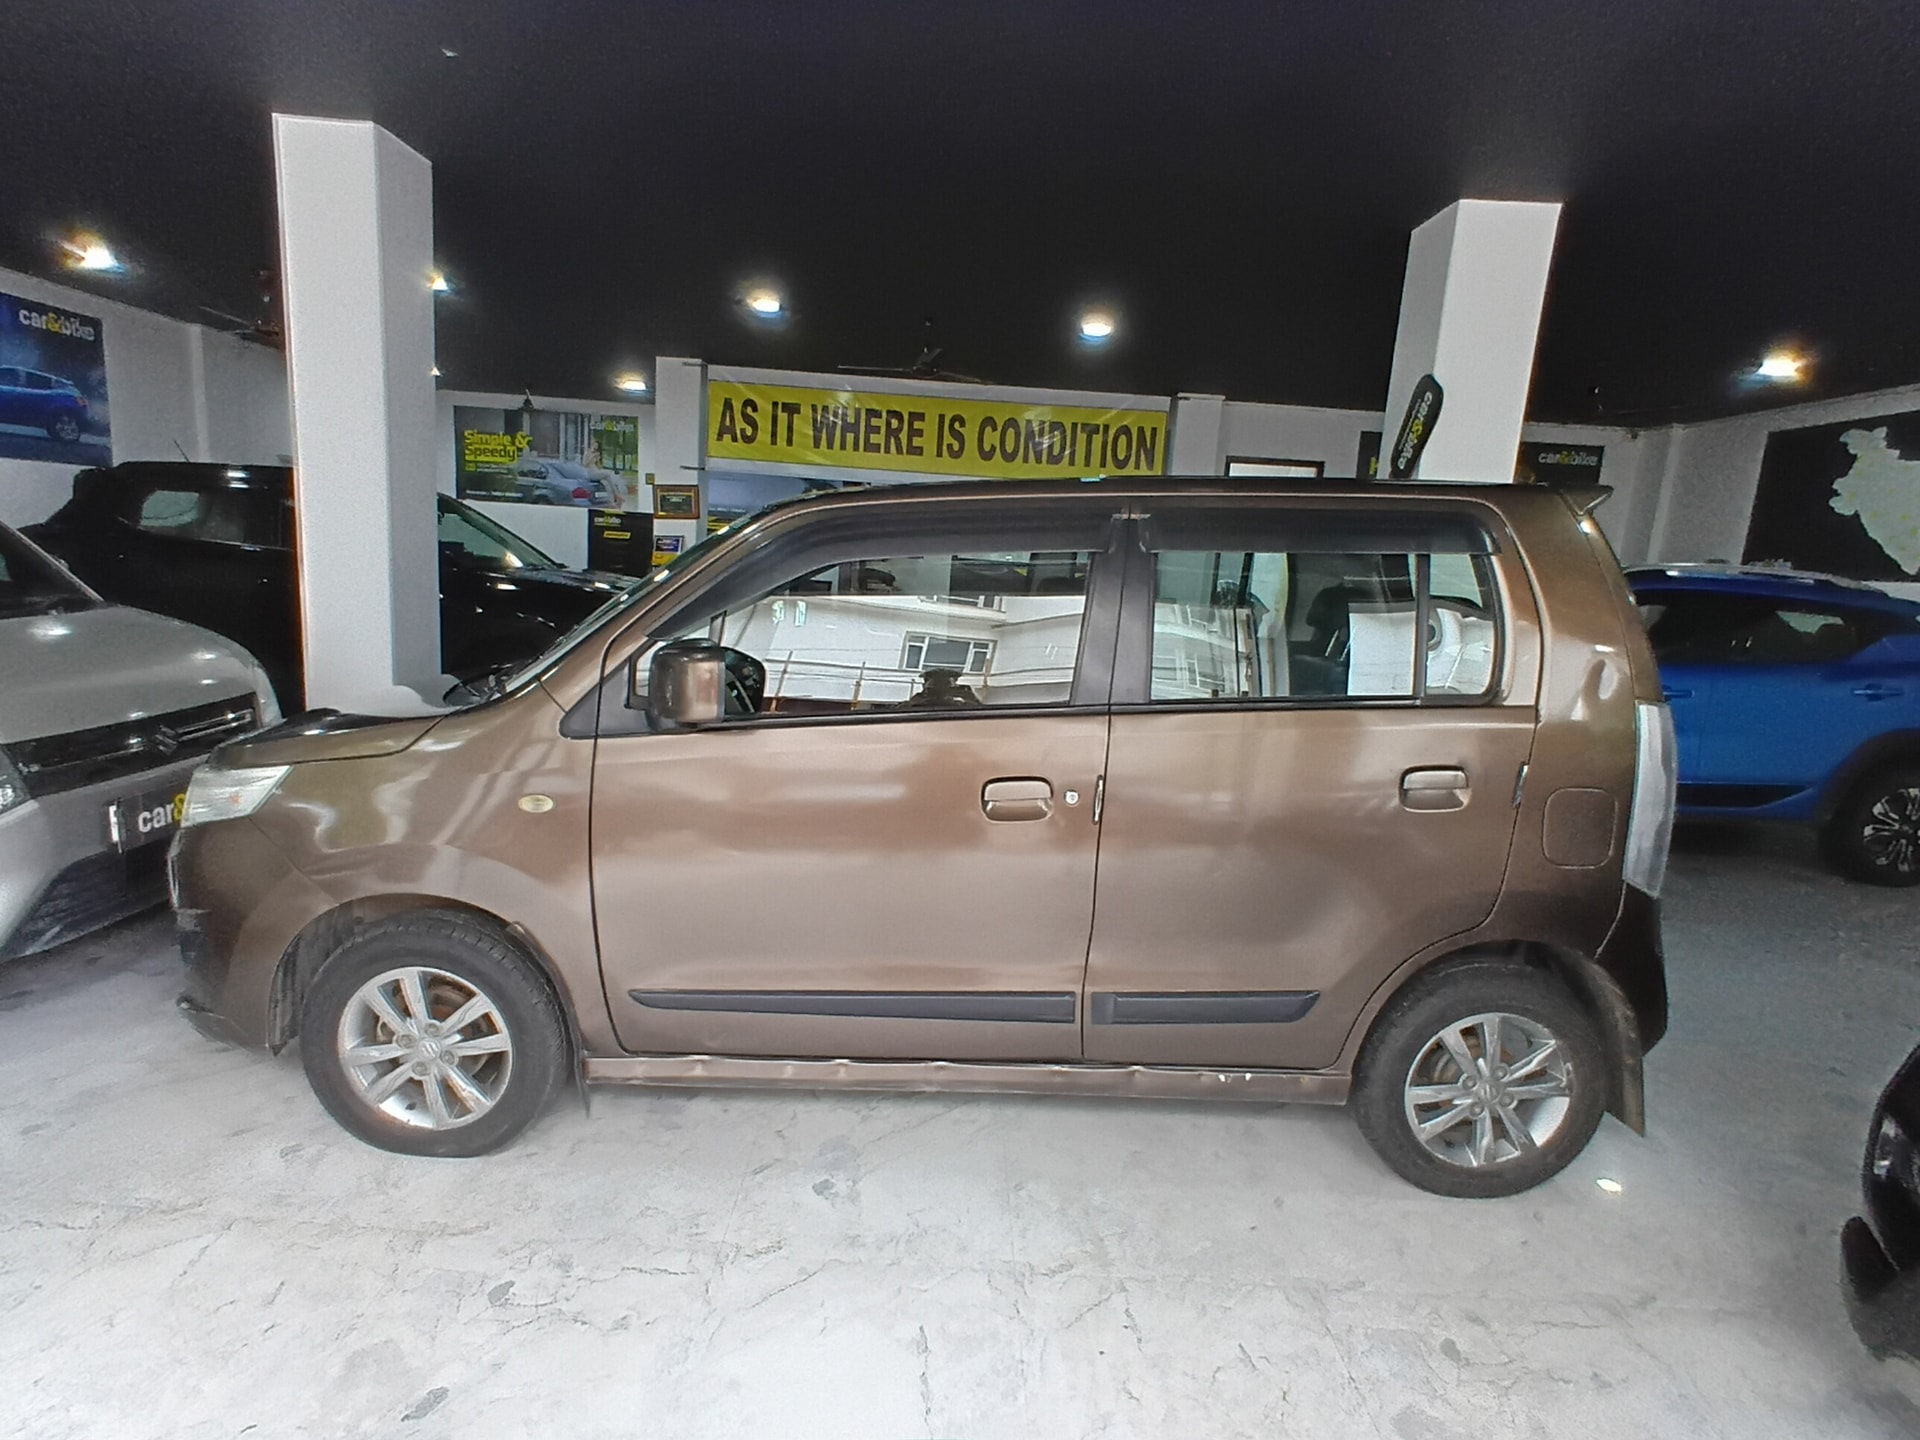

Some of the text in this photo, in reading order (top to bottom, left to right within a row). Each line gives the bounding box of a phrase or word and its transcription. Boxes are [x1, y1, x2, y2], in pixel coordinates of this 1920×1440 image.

[464, 429, 533, 450] Simple &
[716, 397, 1158, 472] AS IT WHERE IS CONDITION
[464, 444, 517, 462] Speedy
[1538, 450, 1599, 466] car&bike
